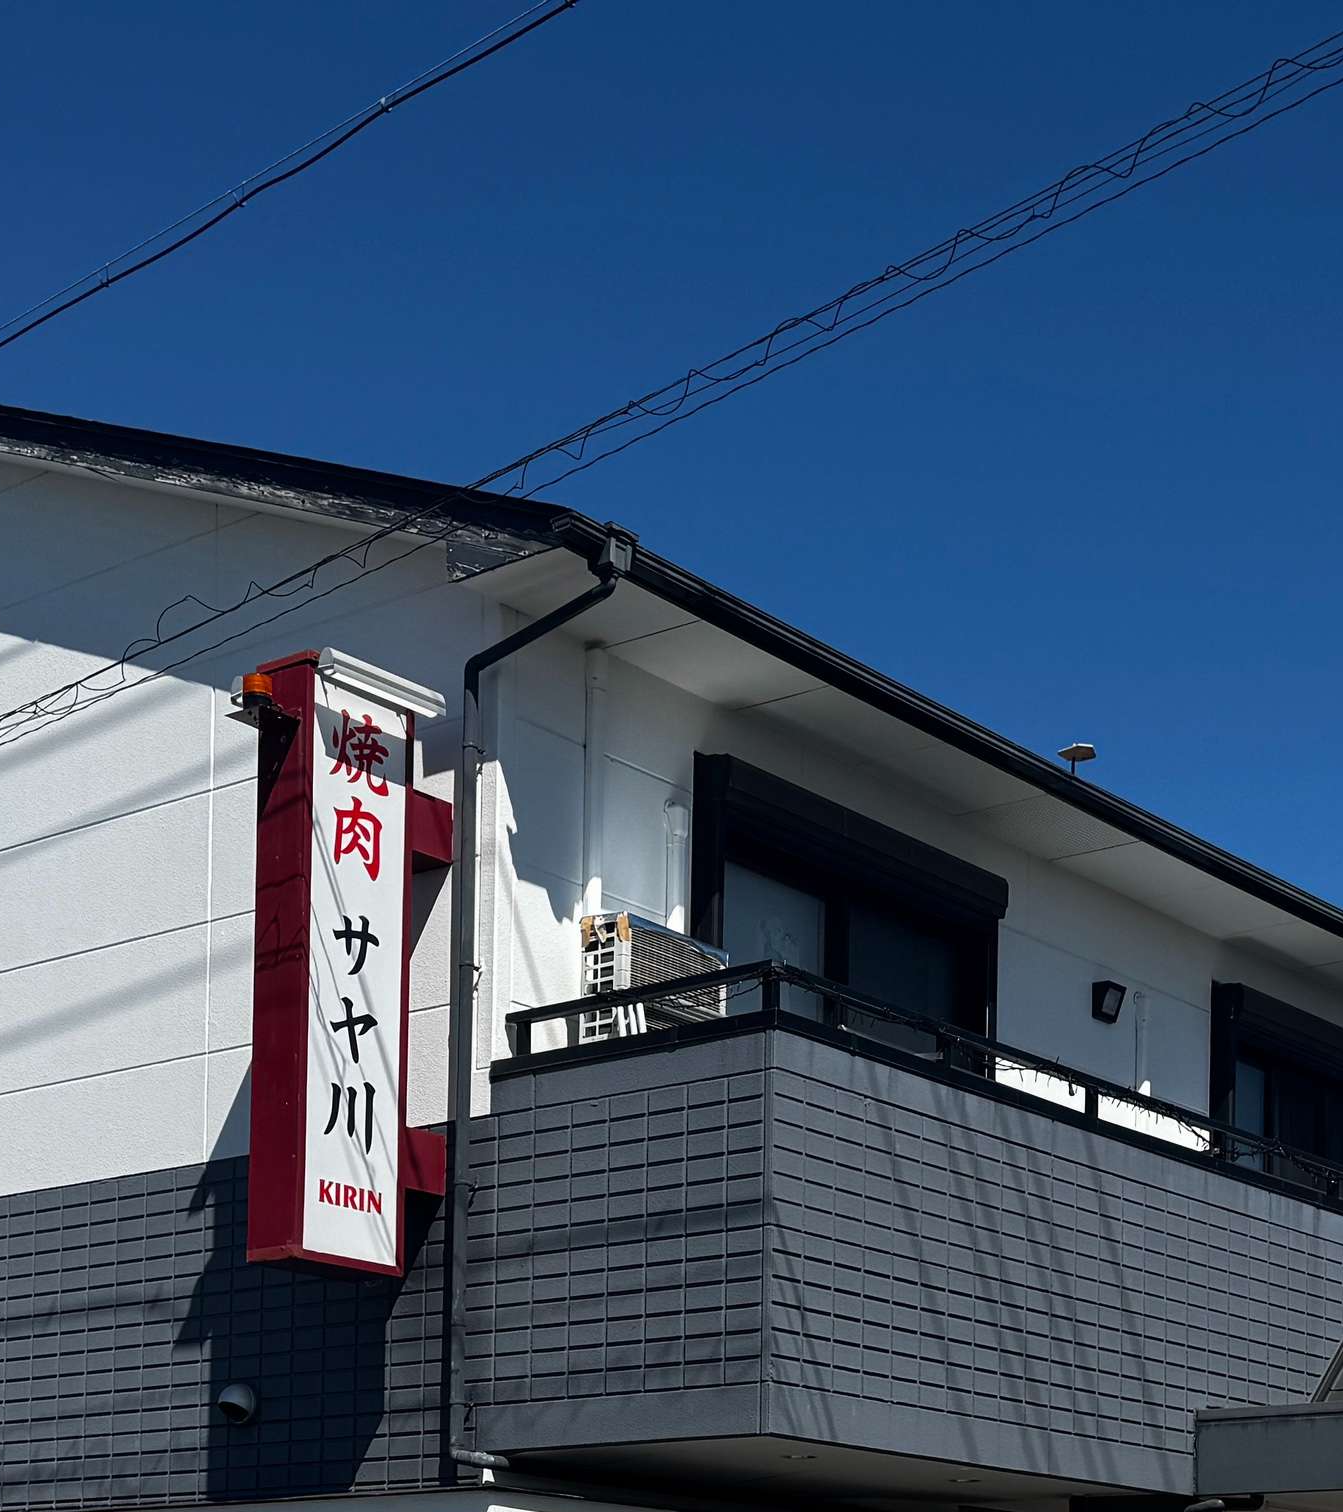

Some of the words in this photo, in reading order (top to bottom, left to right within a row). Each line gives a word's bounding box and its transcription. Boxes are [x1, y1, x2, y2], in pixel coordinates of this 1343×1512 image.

[329, 708, 390, 882] 焼肉
[323, 914, 381, 1156] サヤ川
[318, 1178, 384, 1216] KIRIN
